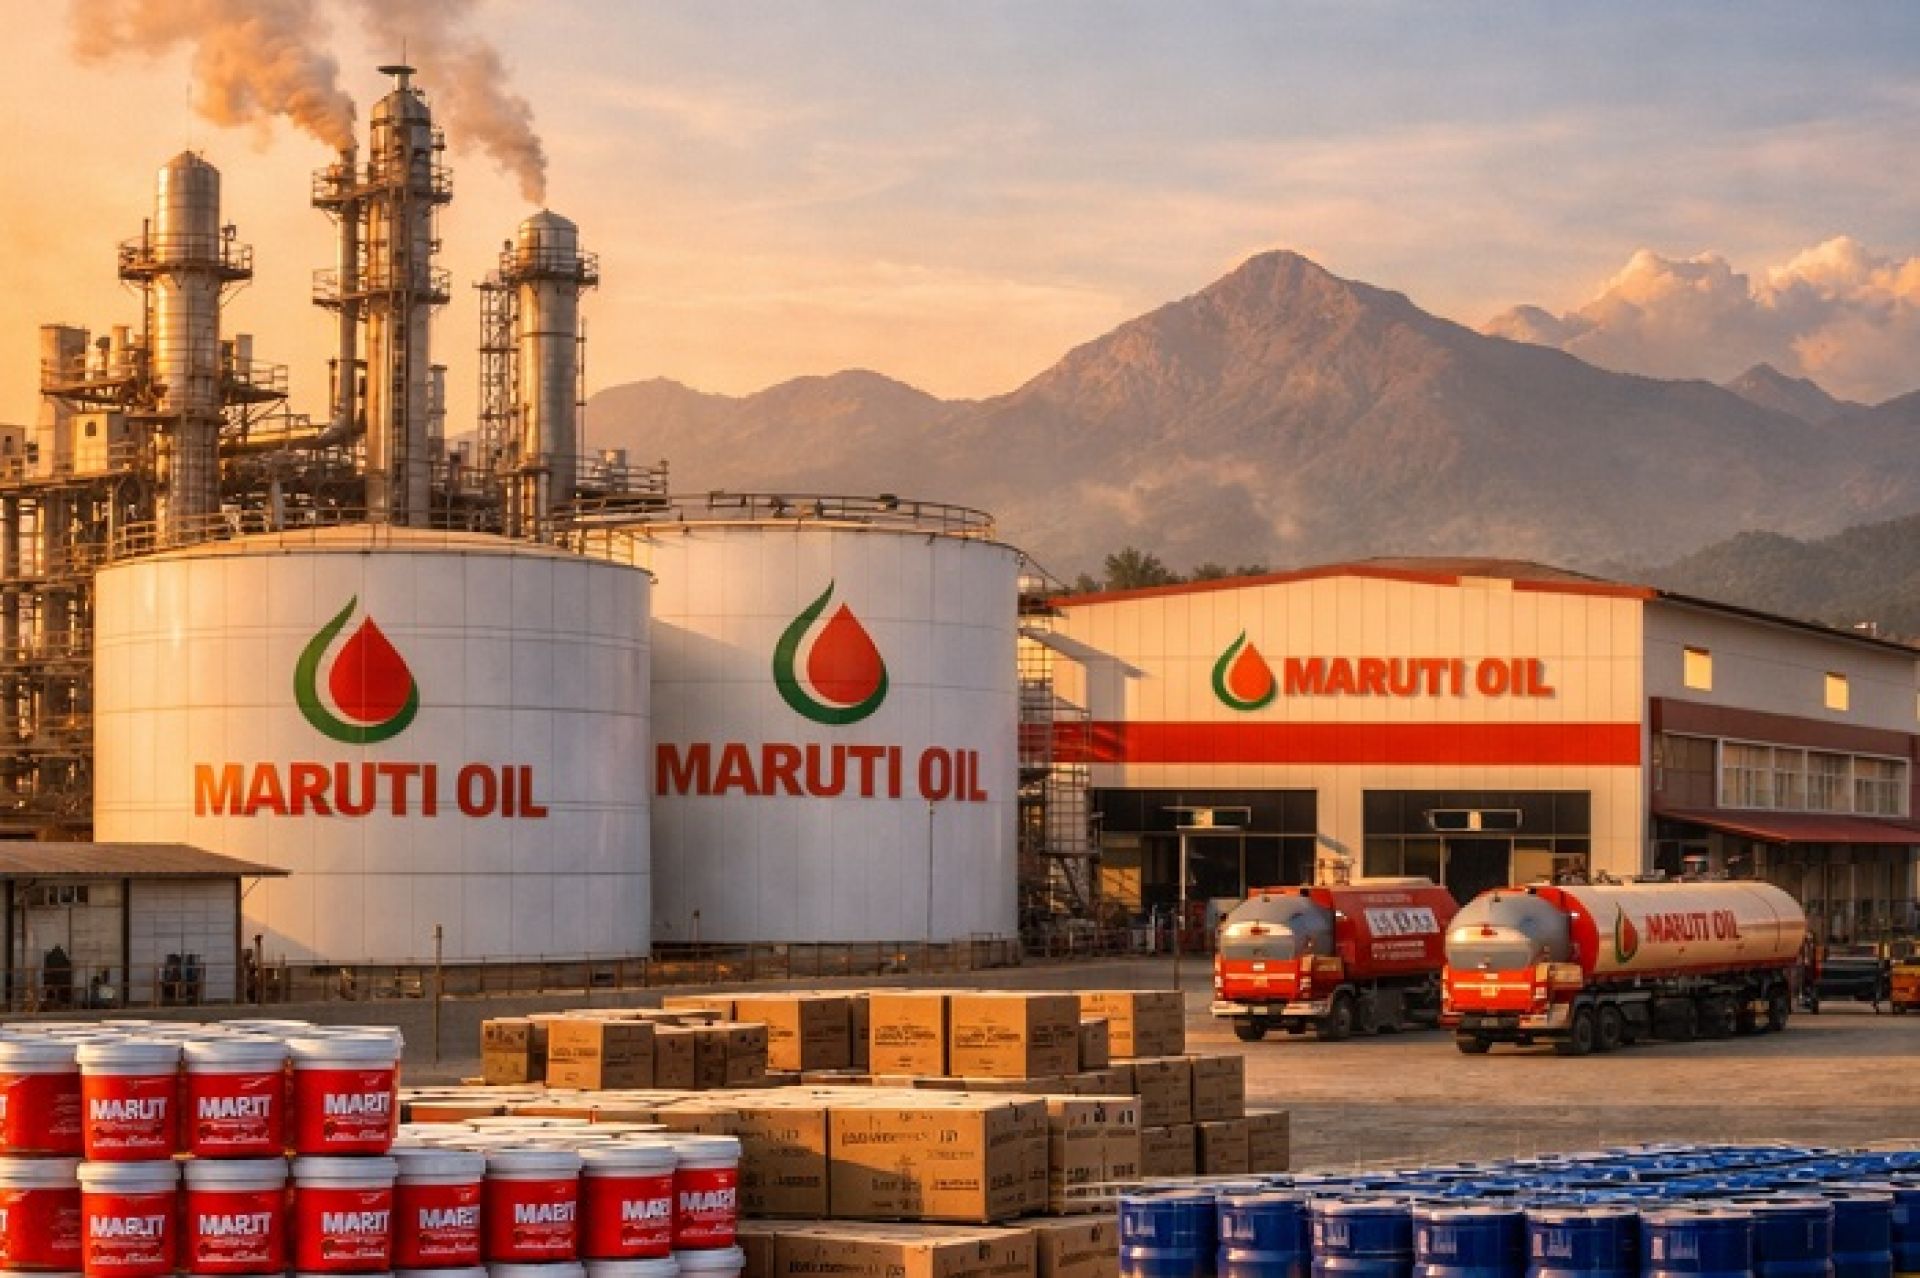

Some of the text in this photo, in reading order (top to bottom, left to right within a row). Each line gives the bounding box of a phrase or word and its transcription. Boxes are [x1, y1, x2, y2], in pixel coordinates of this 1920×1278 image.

[1284, 657, 1556, 698] MARUTI OIL
[194, 762, 549, 818] MARUTI OIL
[655, 742, 988, 802] MARUTI OIL
[1645, 910, 1742, 944] MARUTI OIL
